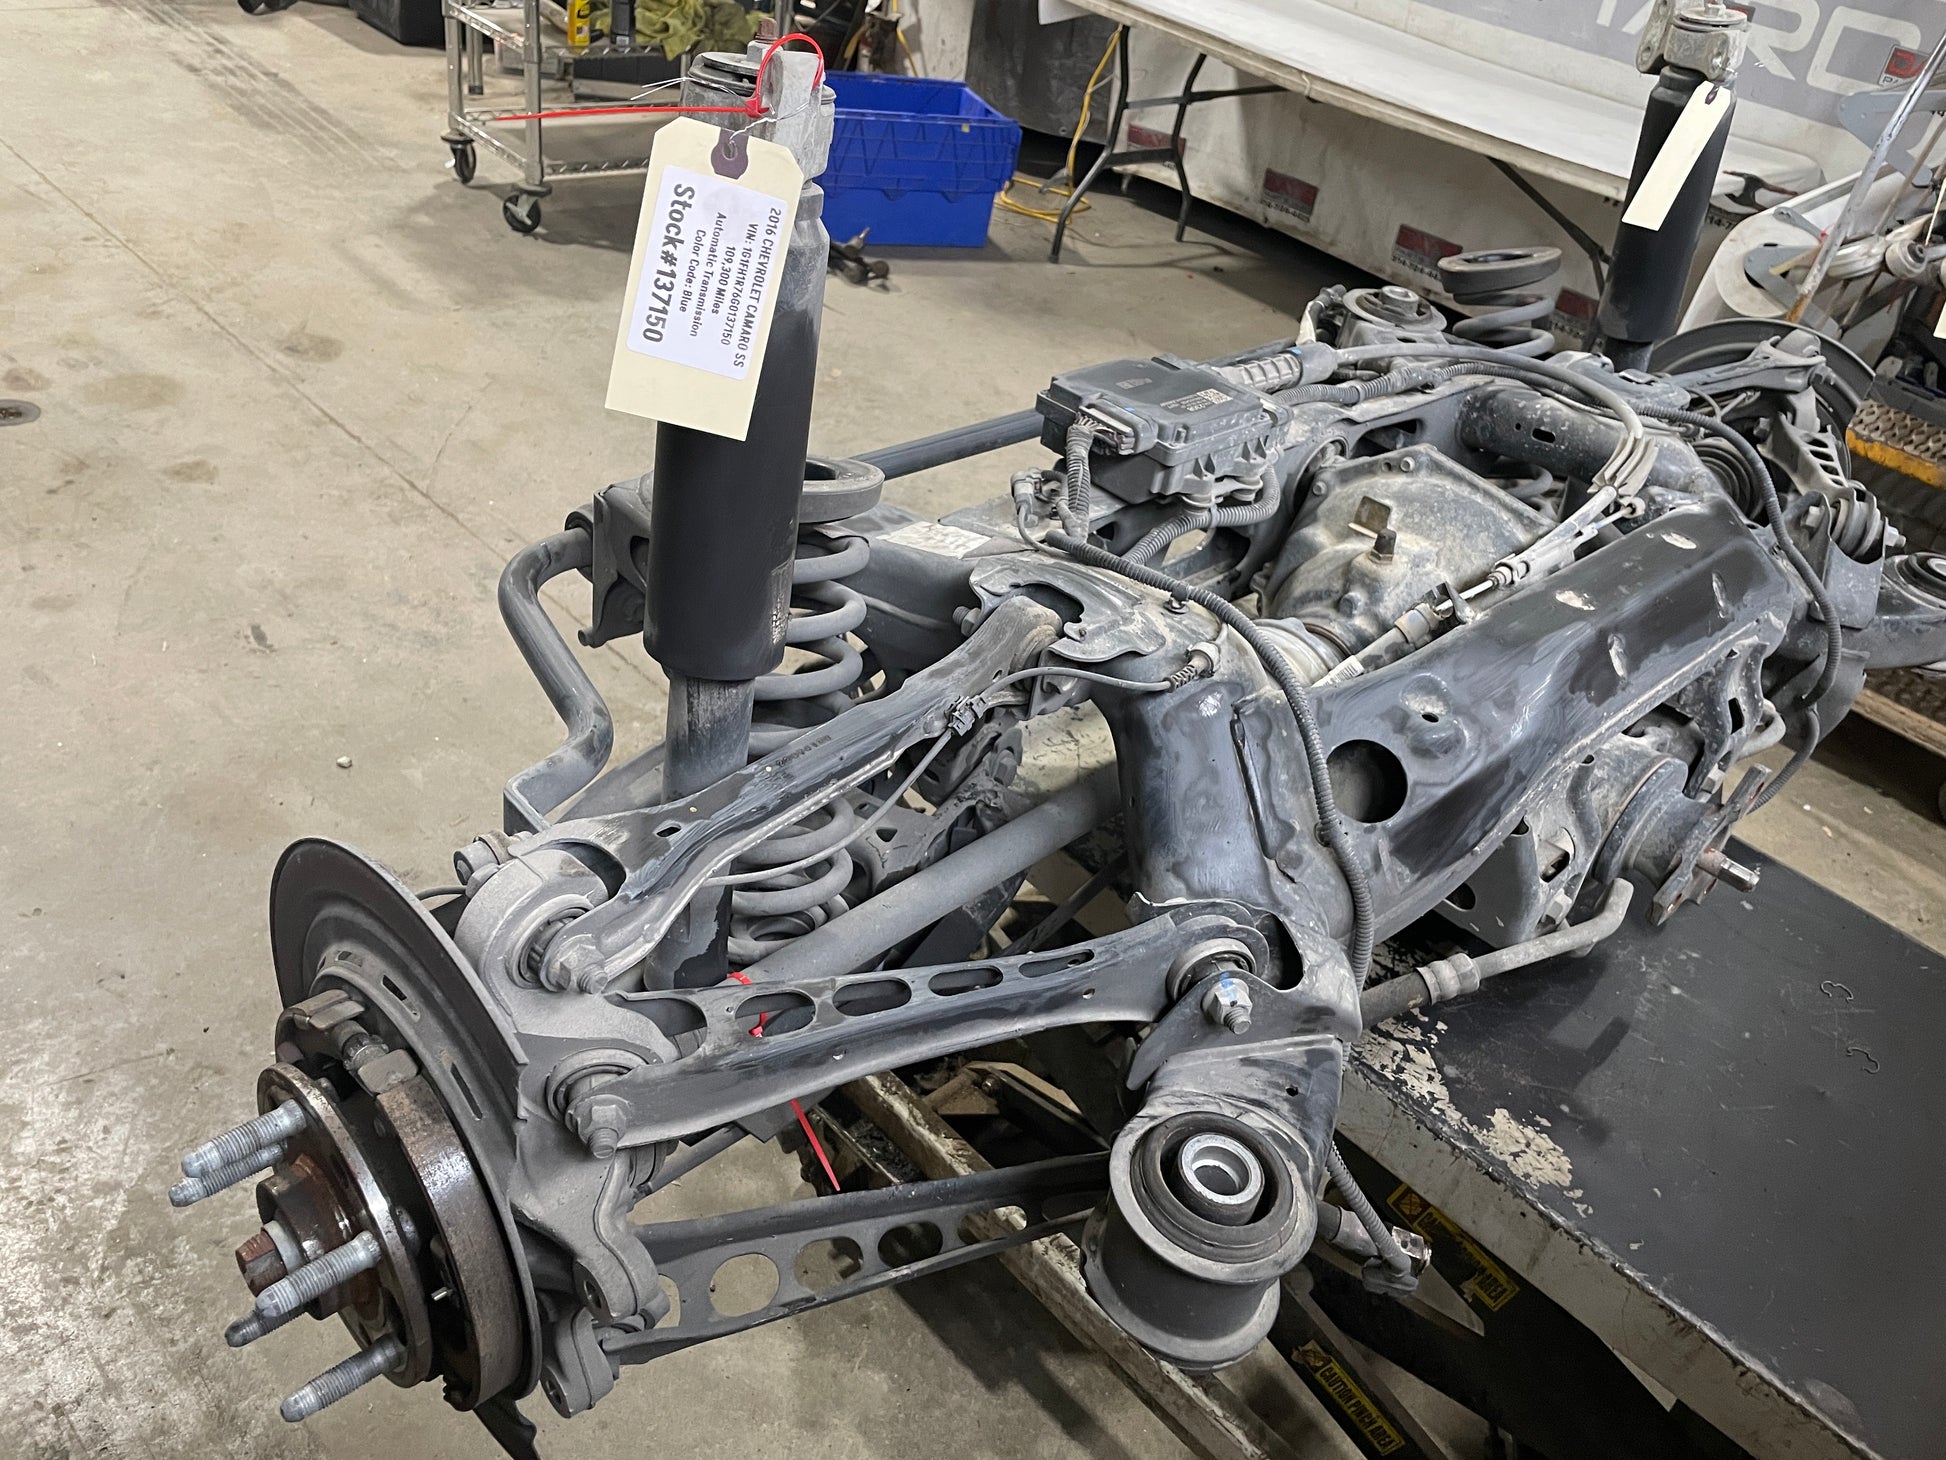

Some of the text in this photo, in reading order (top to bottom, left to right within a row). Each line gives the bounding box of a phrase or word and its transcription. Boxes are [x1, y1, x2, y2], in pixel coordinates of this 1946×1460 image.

[642, 183, 696, 343] Stock#137150
[679, 229, 707, 313] Color Code: Blue
[689, 211, 727, 337] Automatic Transmission
[711, 246, 737, 315] 109,300 Miles
[720, 223, 759, 347] VIN: 1G1FH1R76G0137150
[733, 207, 782, 368] 2016 CHEVROLET CAMARO SS
[1319, 1366, 1396, 1450] CAUTION PINCH AREA
